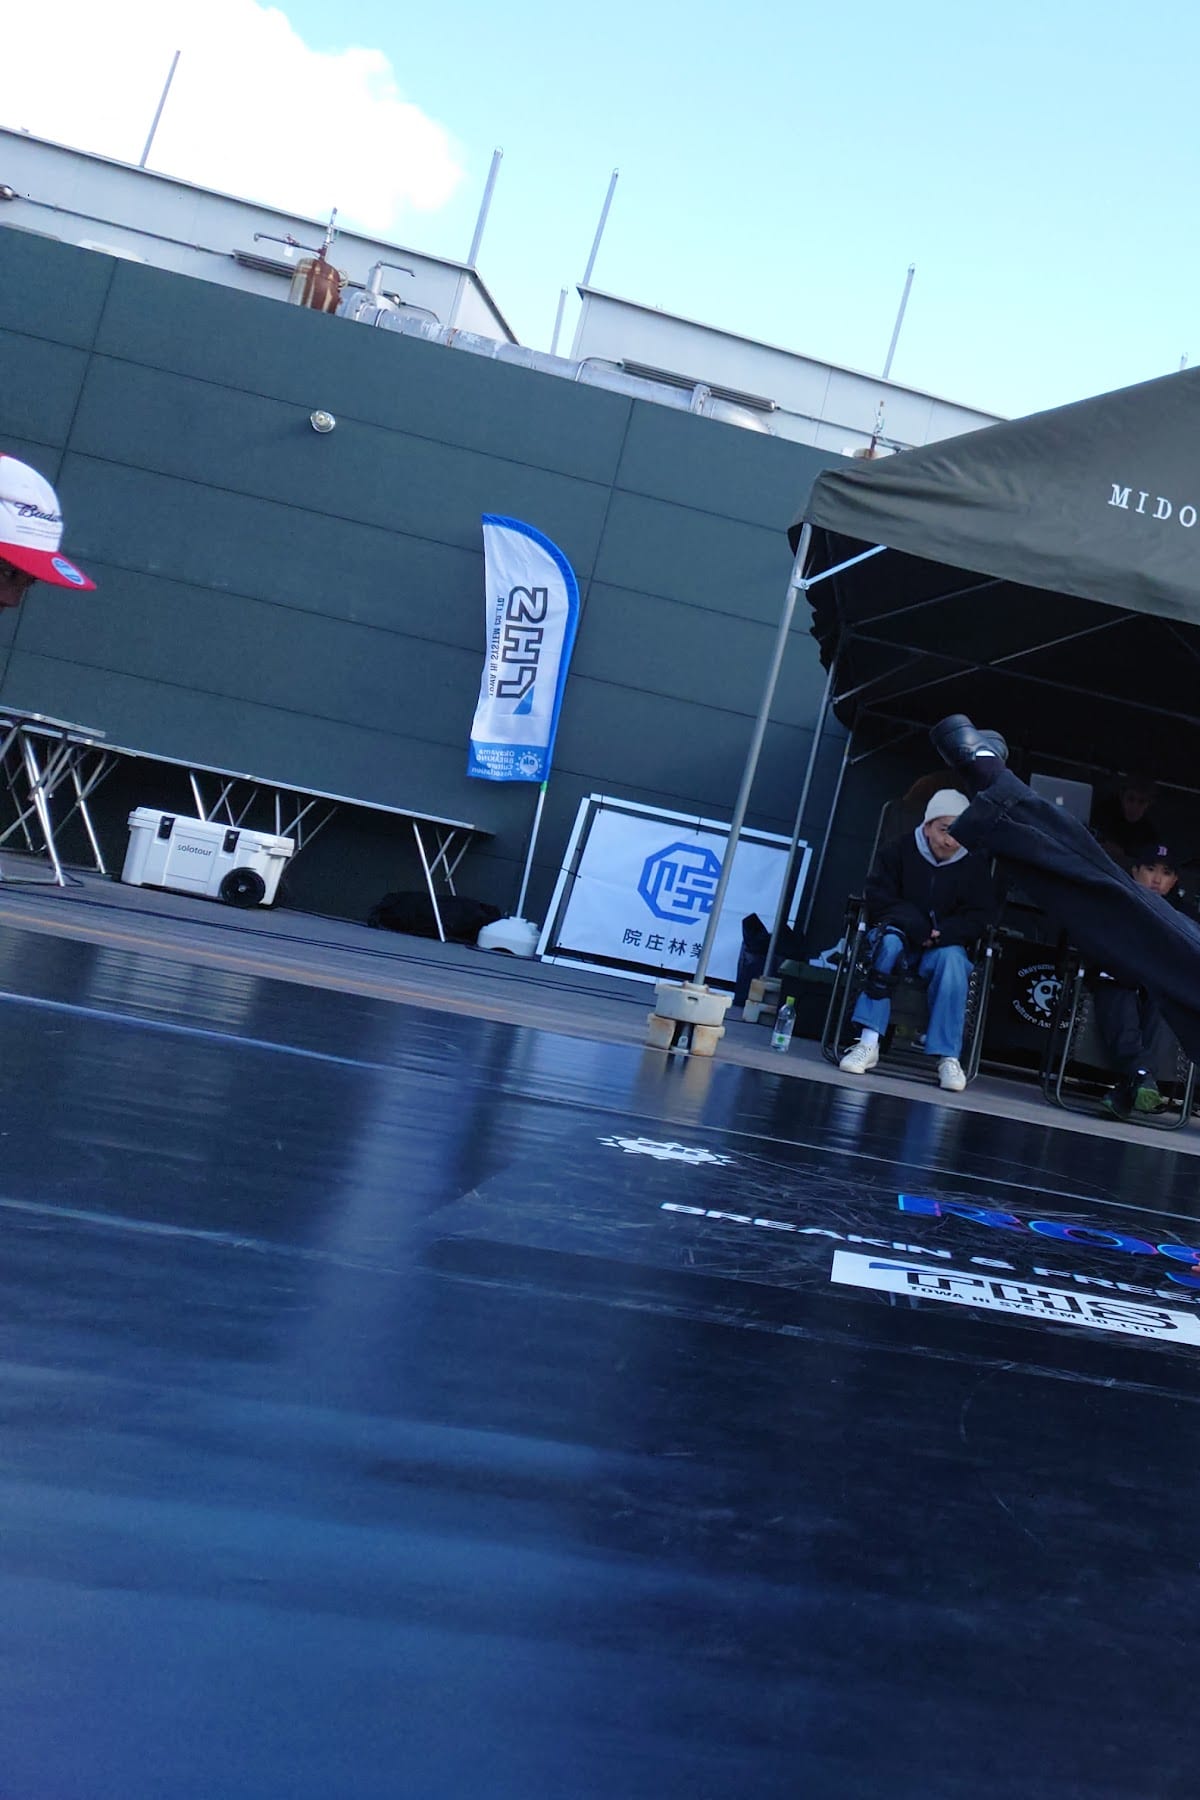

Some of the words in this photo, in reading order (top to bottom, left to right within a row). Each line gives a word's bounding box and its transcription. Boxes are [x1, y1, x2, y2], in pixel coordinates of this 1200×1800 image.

[177, 843, 213, 857] solotour
[660, 1202, 952, 1259] BREAKIN
[969, 1256, 1016, 1271] &
[909, 1285, 964, 1300] TOWA
[999, 1301, 1076, 1320] SYSTEM
